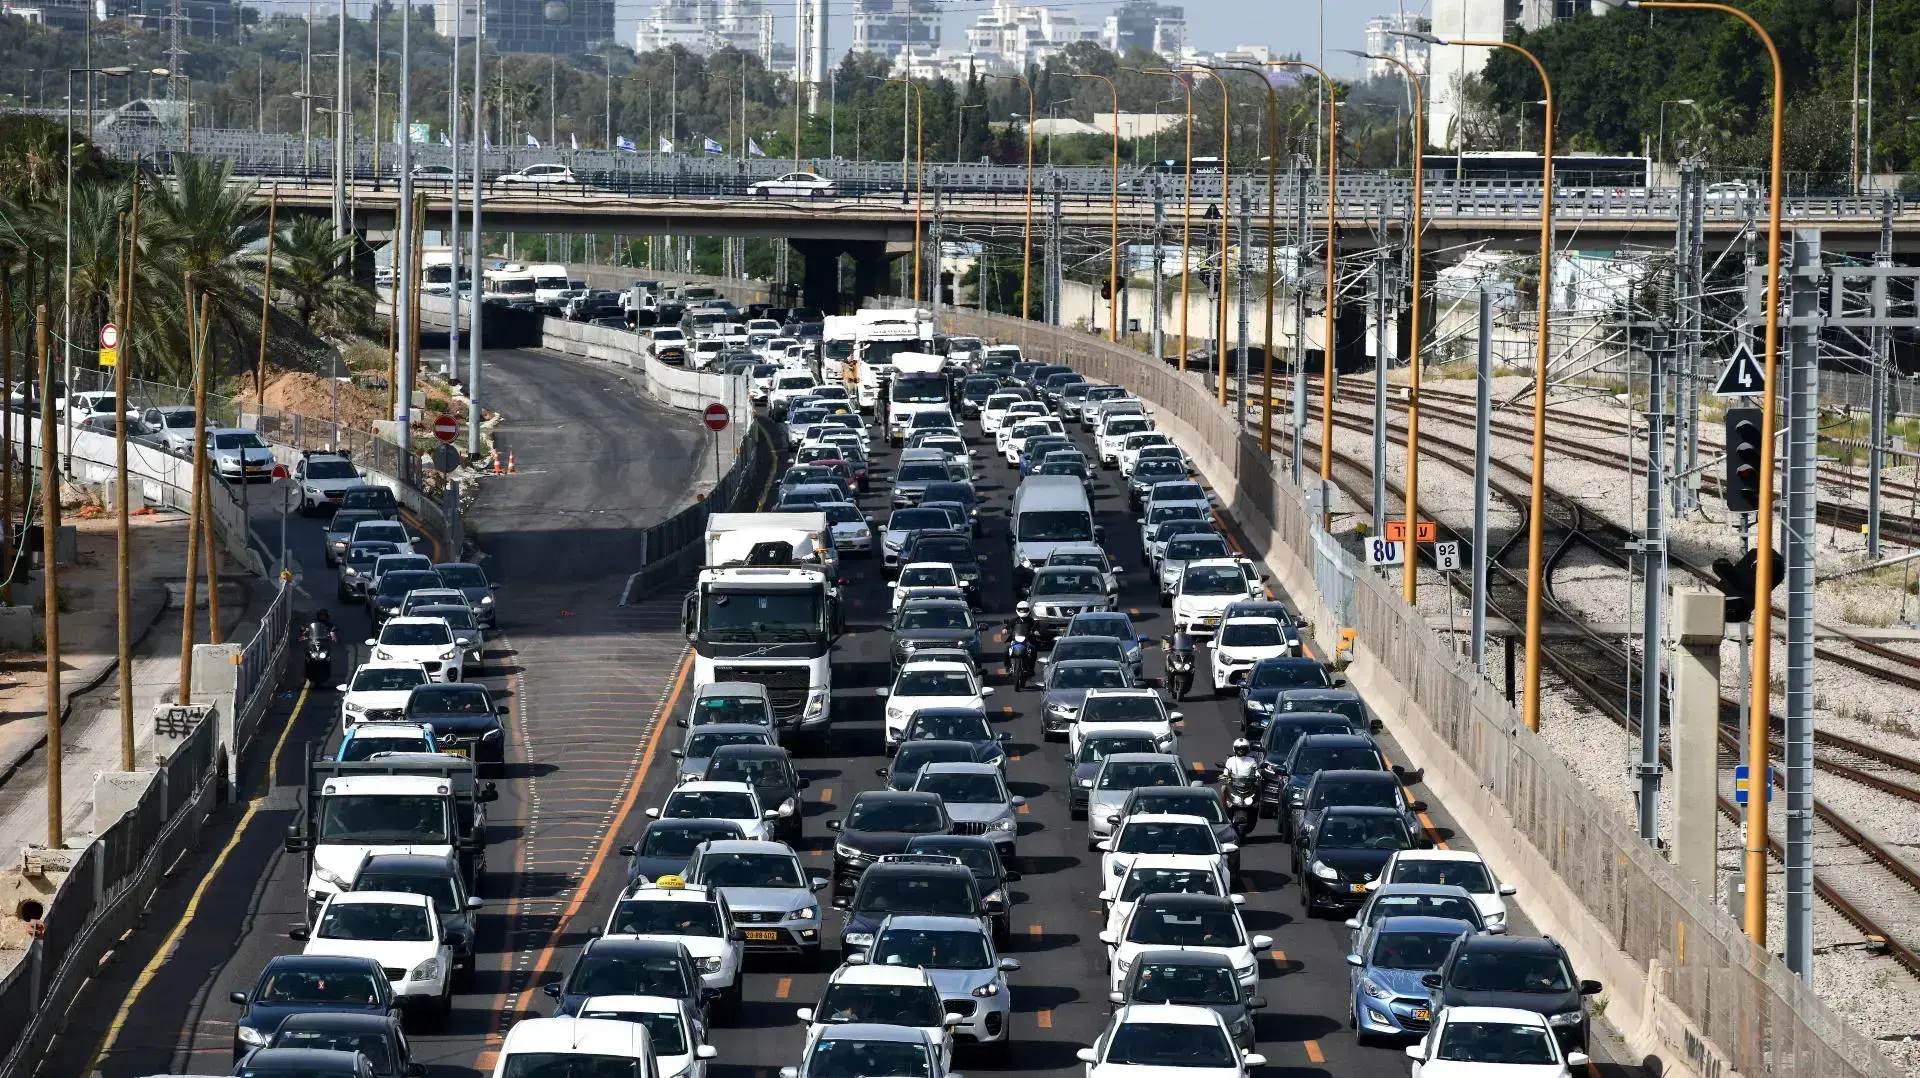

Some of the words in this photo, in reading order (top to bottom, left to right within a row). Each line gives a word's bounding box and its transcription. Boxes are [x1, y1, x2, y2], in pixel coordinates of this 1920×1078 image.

[1738, 359, 1752, 388] 4
[1394, 526, 1428, 538] עור
[1374, 540, 1396, 562] 80
[1438, 543, 1456, 556] 92
[1444, 557, 1452, 568] 8
